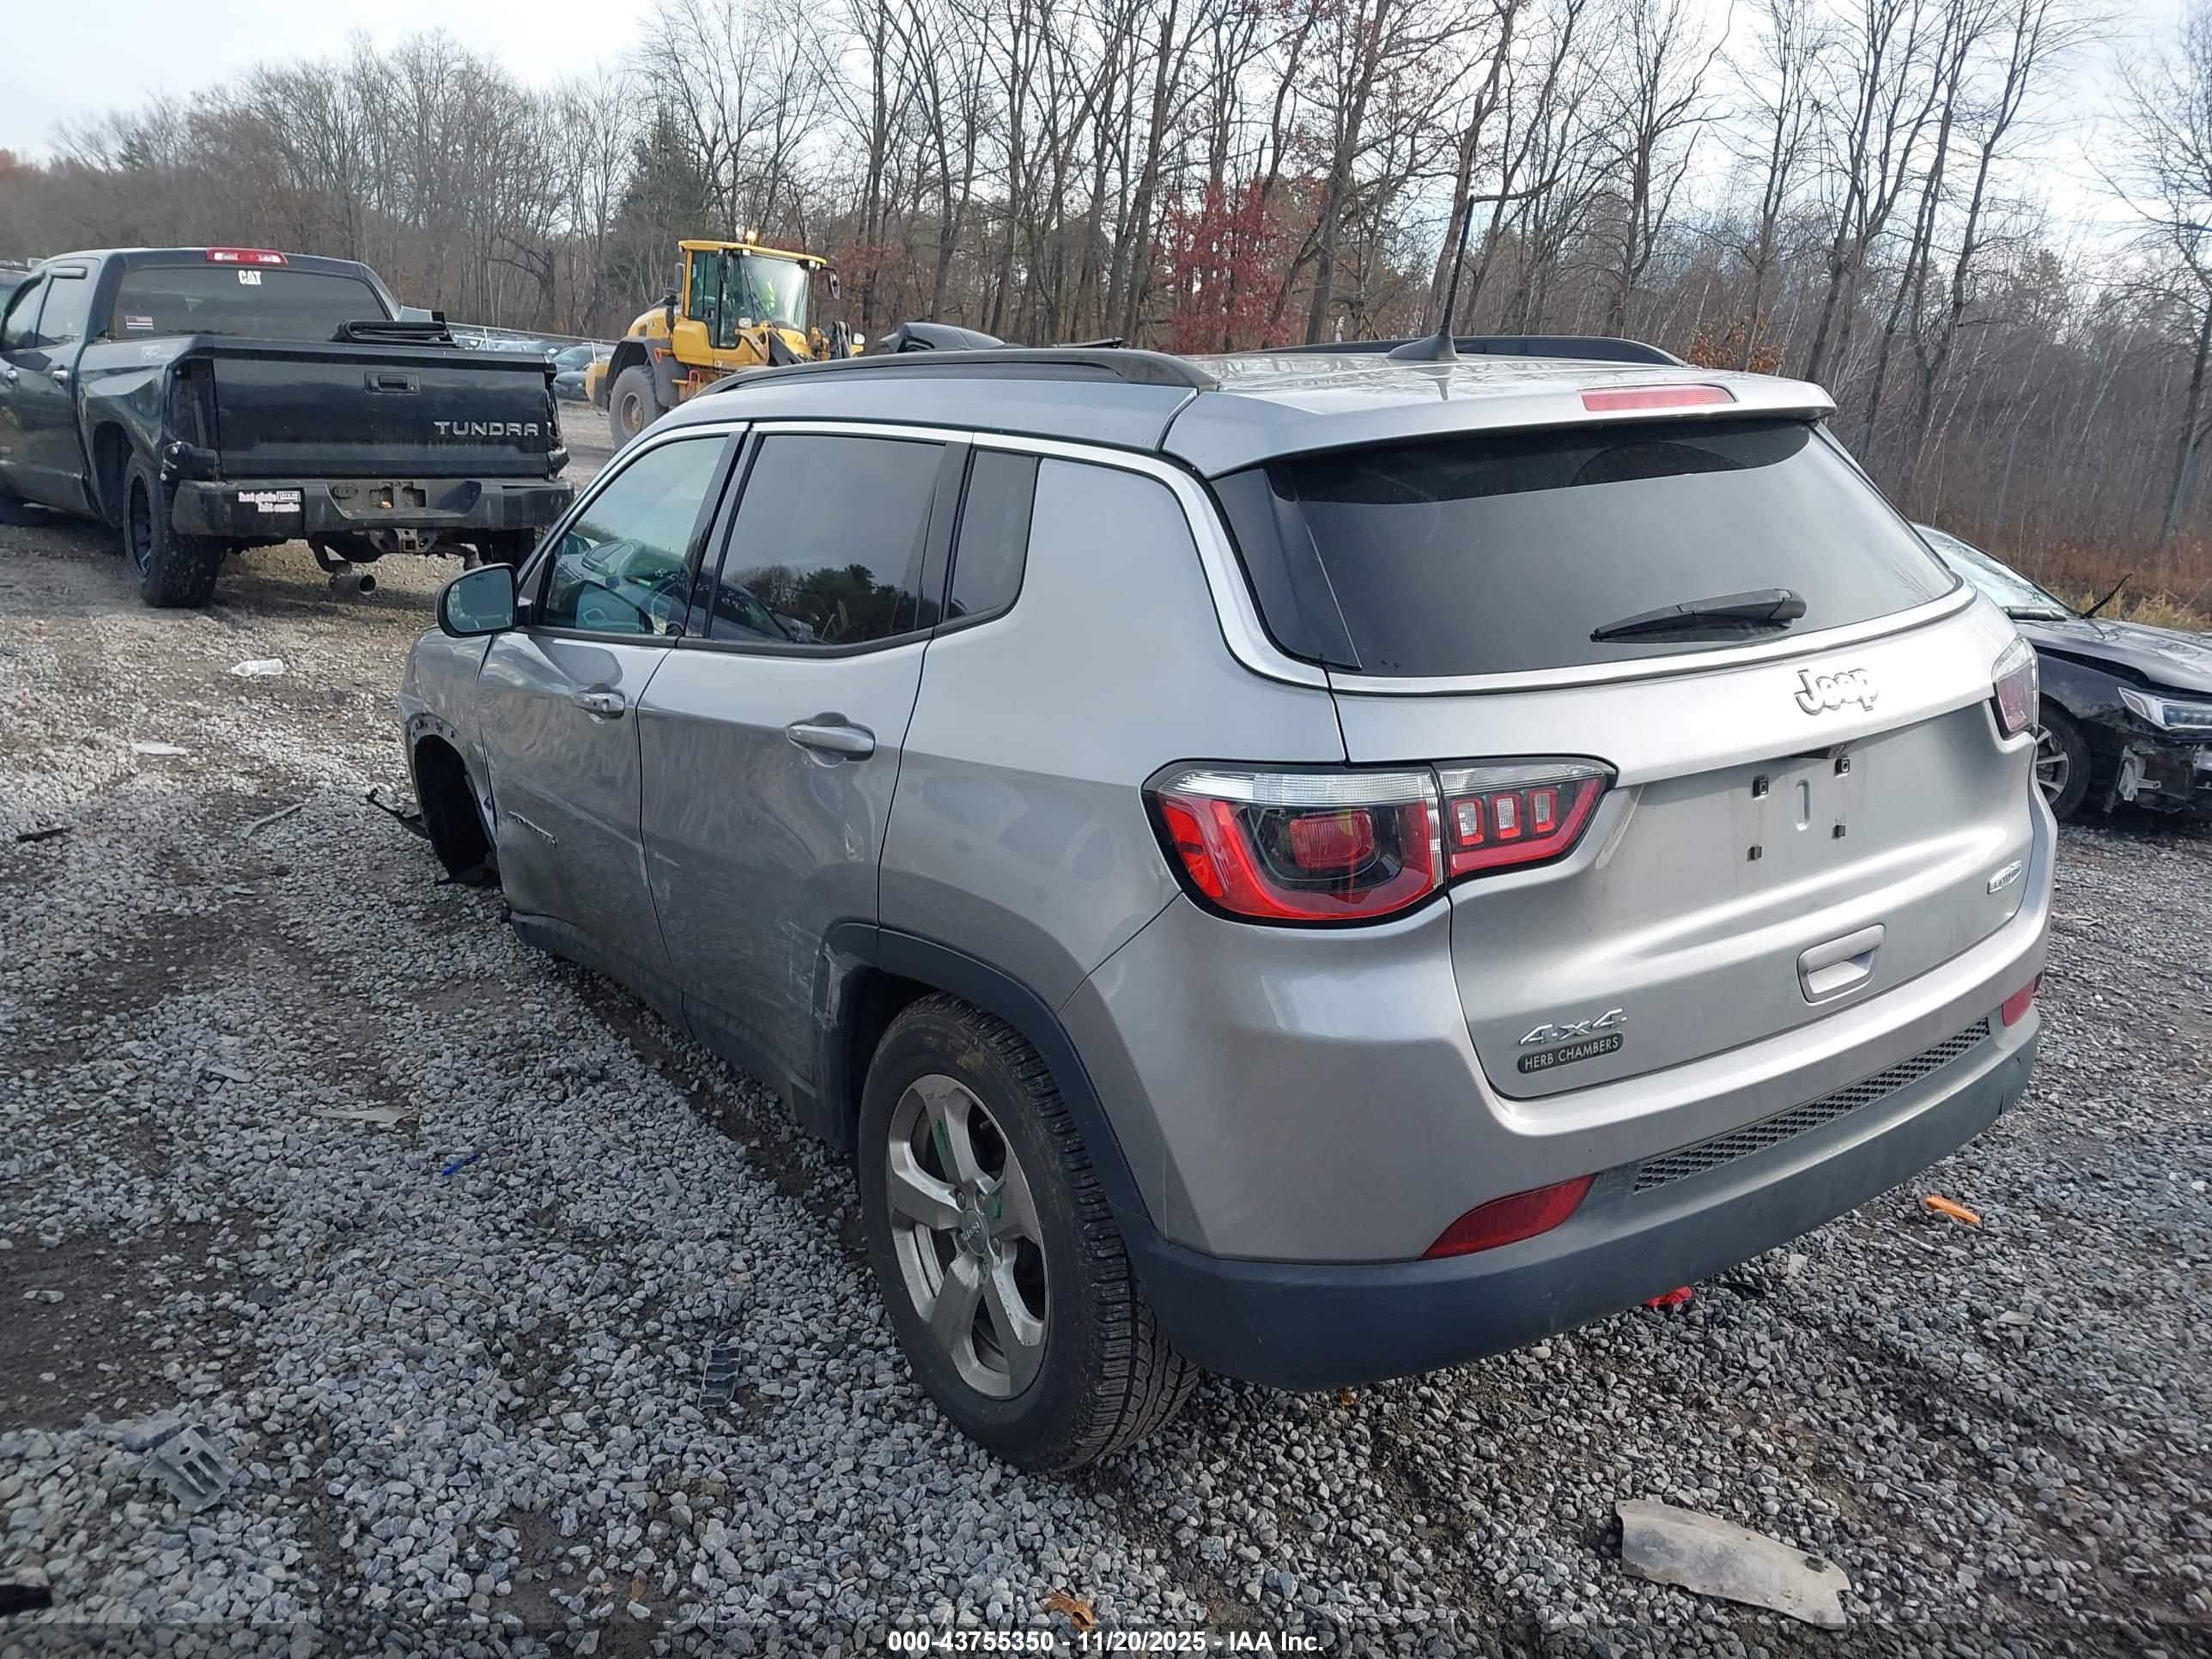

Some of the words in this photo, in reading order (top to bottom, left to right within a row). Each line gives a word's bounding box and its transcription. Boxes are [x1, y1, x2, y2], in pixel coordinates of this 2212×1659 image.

[238, 270, 261, 285] CAT
[434, 421, 539, 436] TUNDRA
[1793, 668, 1879, 715] Jeep
[1519, 1008, 1627, 1045] 4x4
[1524, 1053, 1553, 1071] HERB
[1559, 1036, 1619, 1061] CHAMBERS
